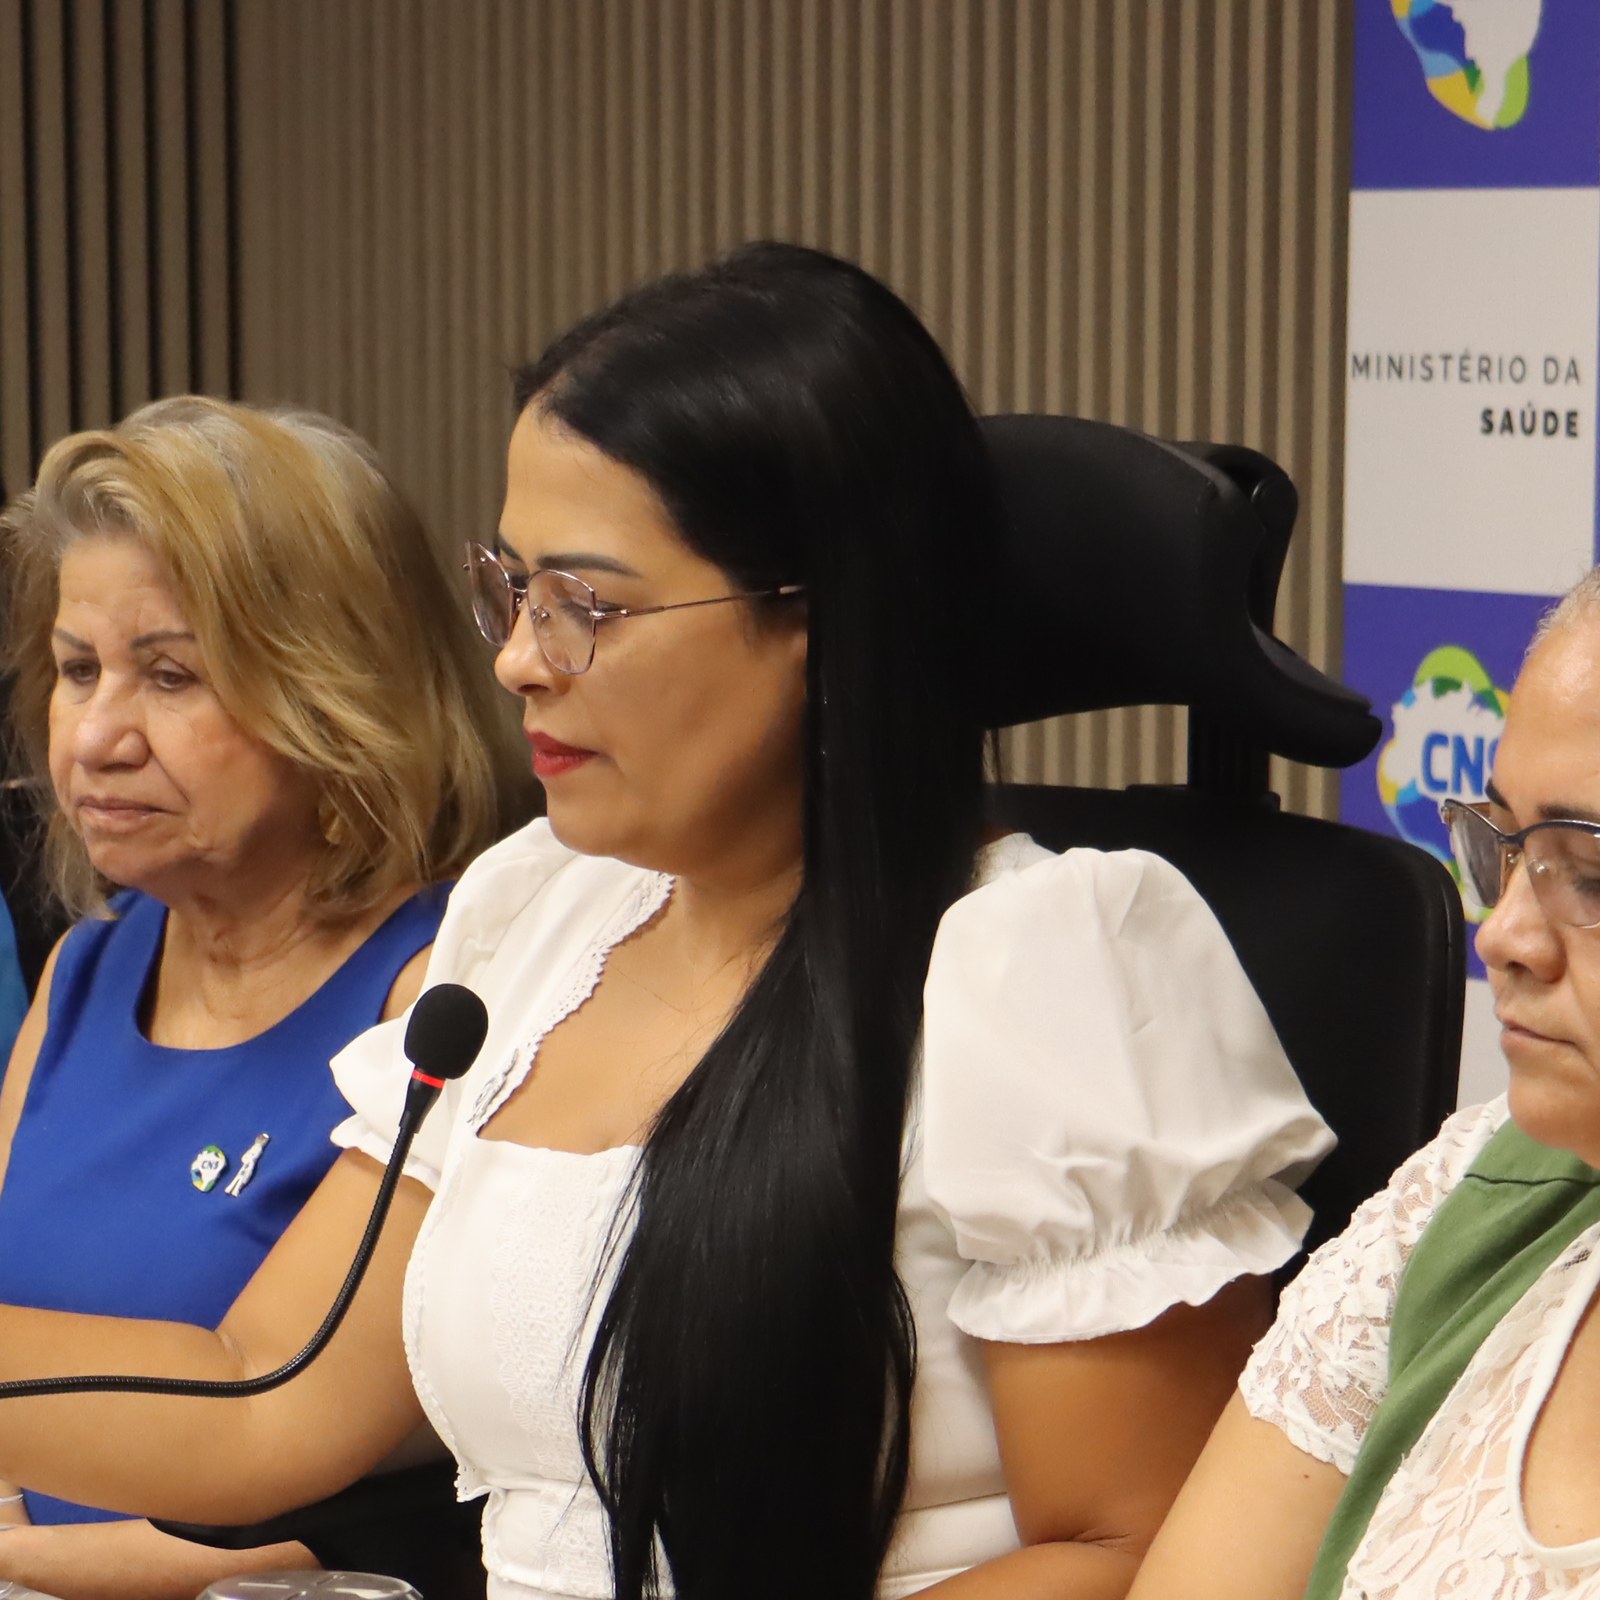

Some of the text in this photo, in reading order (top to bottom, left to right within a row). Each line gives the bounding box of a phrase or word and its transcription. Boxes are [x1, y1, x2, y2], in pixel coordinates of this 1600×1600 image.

[1351, 351, 1581, 386] MINISTÉRIO DA
[1479, 402, 1580, 438] SAÚDE
[1421, 731, 1498, 796] CN
